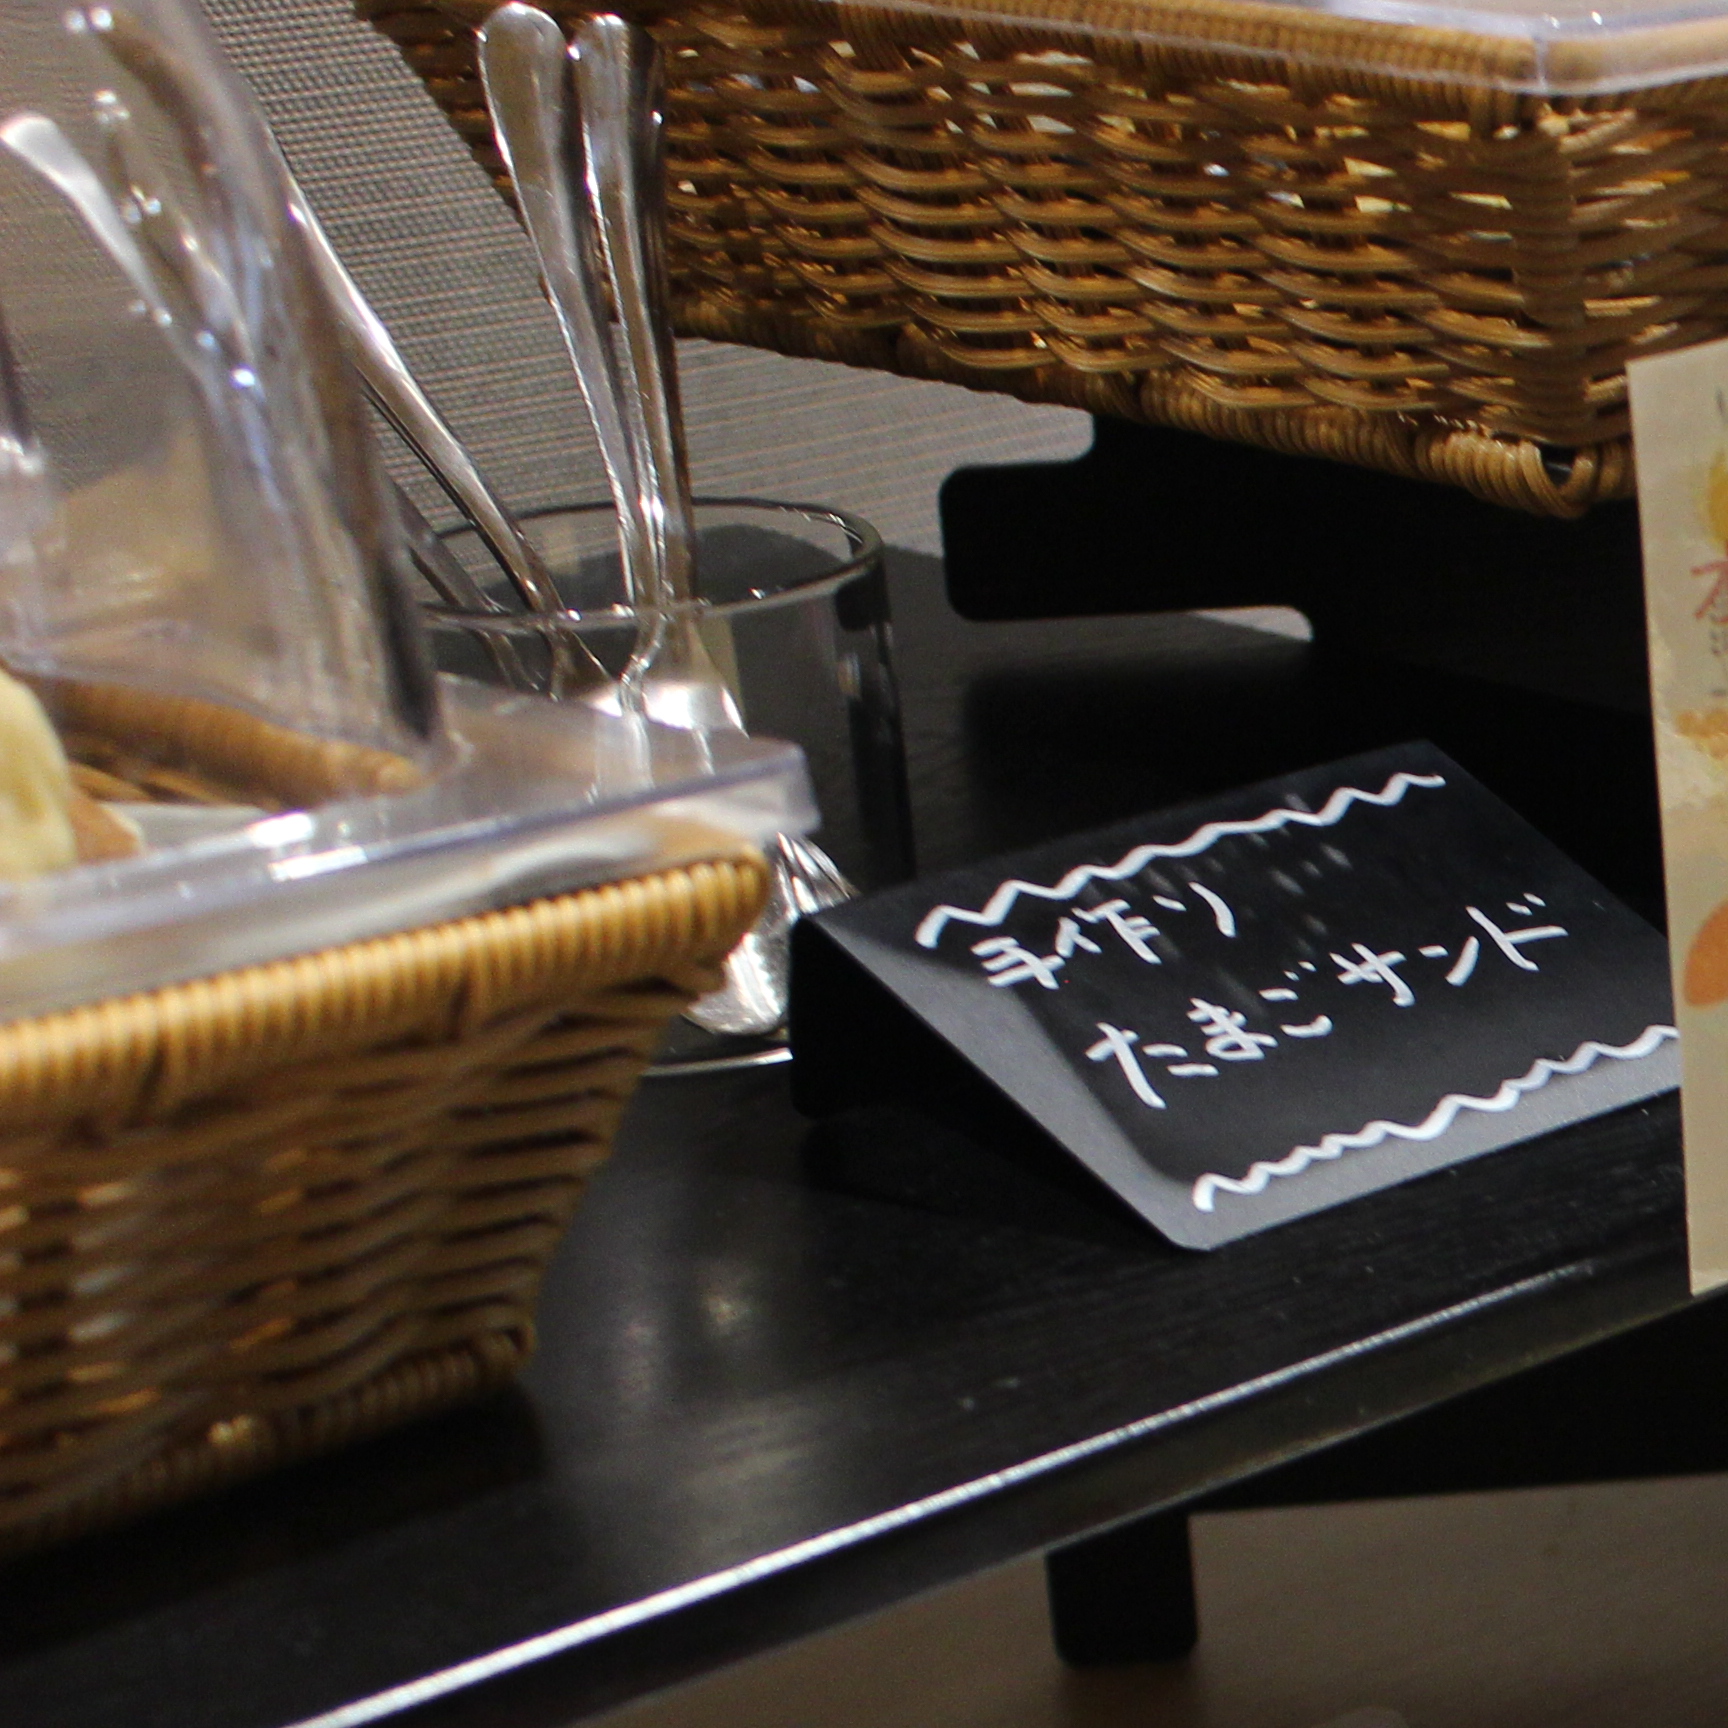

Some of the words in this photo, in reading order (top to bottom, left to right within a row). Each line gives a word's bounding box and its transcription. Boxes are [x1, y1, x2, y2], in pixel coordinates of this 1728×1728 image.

[972, 881, 1236, 990] 手作り
[1085, 891, 1568, 1109] たまごサンド
